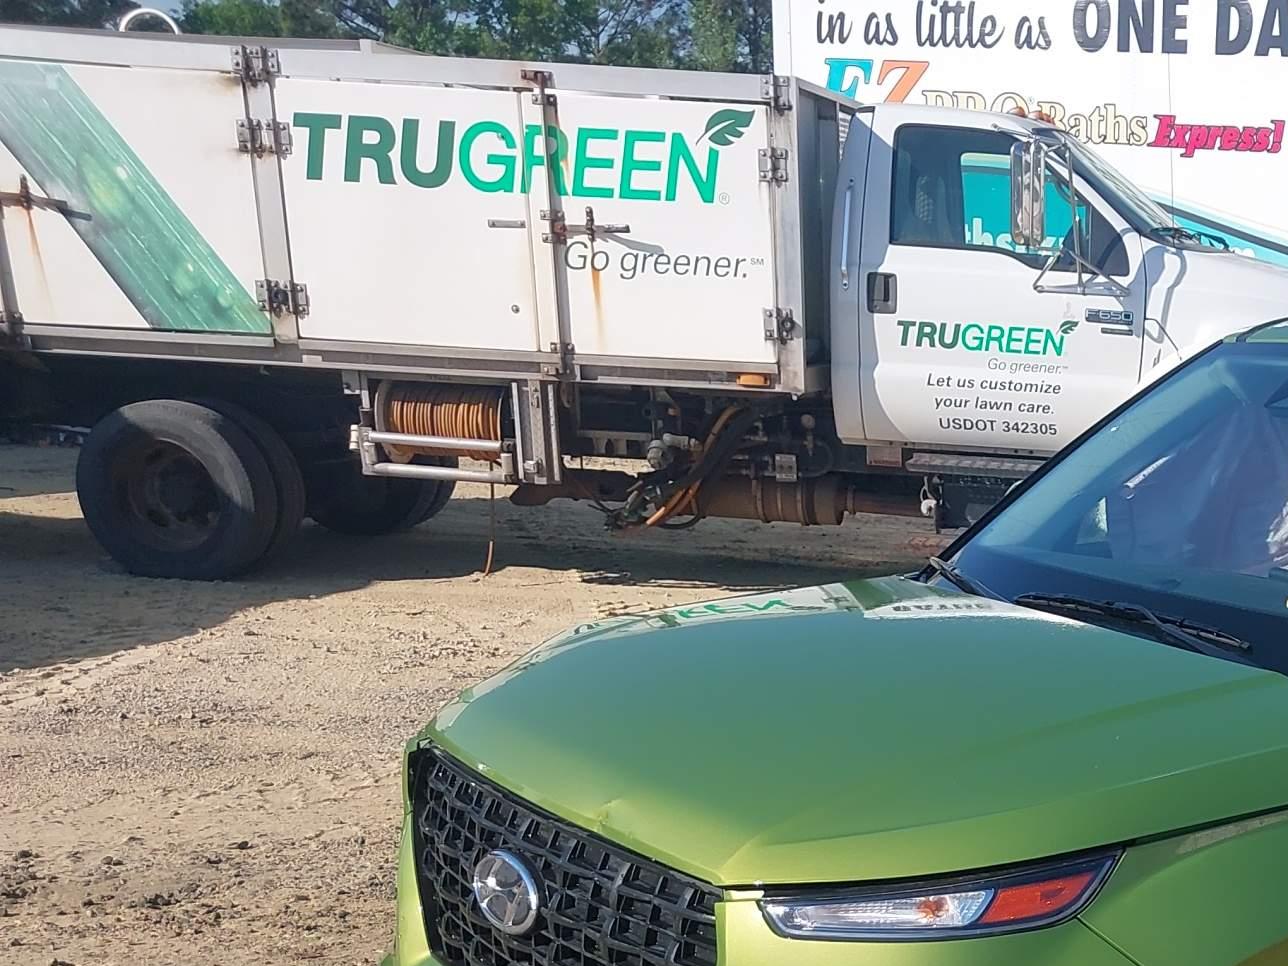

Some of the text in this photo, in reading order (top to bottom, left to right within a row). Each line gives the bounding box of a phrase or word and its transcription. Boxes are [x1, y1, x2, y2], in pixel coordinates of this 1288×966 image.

[816, 0, 852, 45] in
[864, 12, 898, 47] as
[916, 0, 1005, 49] little
[1015, 15, 1052, 50] as
[1072, 0, 1188, 54] ONE
[1147, 113, 1286, 158] Express!
[293, 112, 719, 204] TRUGREEN
[564, 241, 610, 272] Go
[619, 250, 749, 280] greener.
[897, 320, 1065, 357] TRUGREEN
[927, 373, 1062, 395] Let us customize
[987, 358, 1062, 375] Go greener.
[934, 396, 1055, 415] your lawn care.
[939, 417, 1057, 435] USDOT 342305
